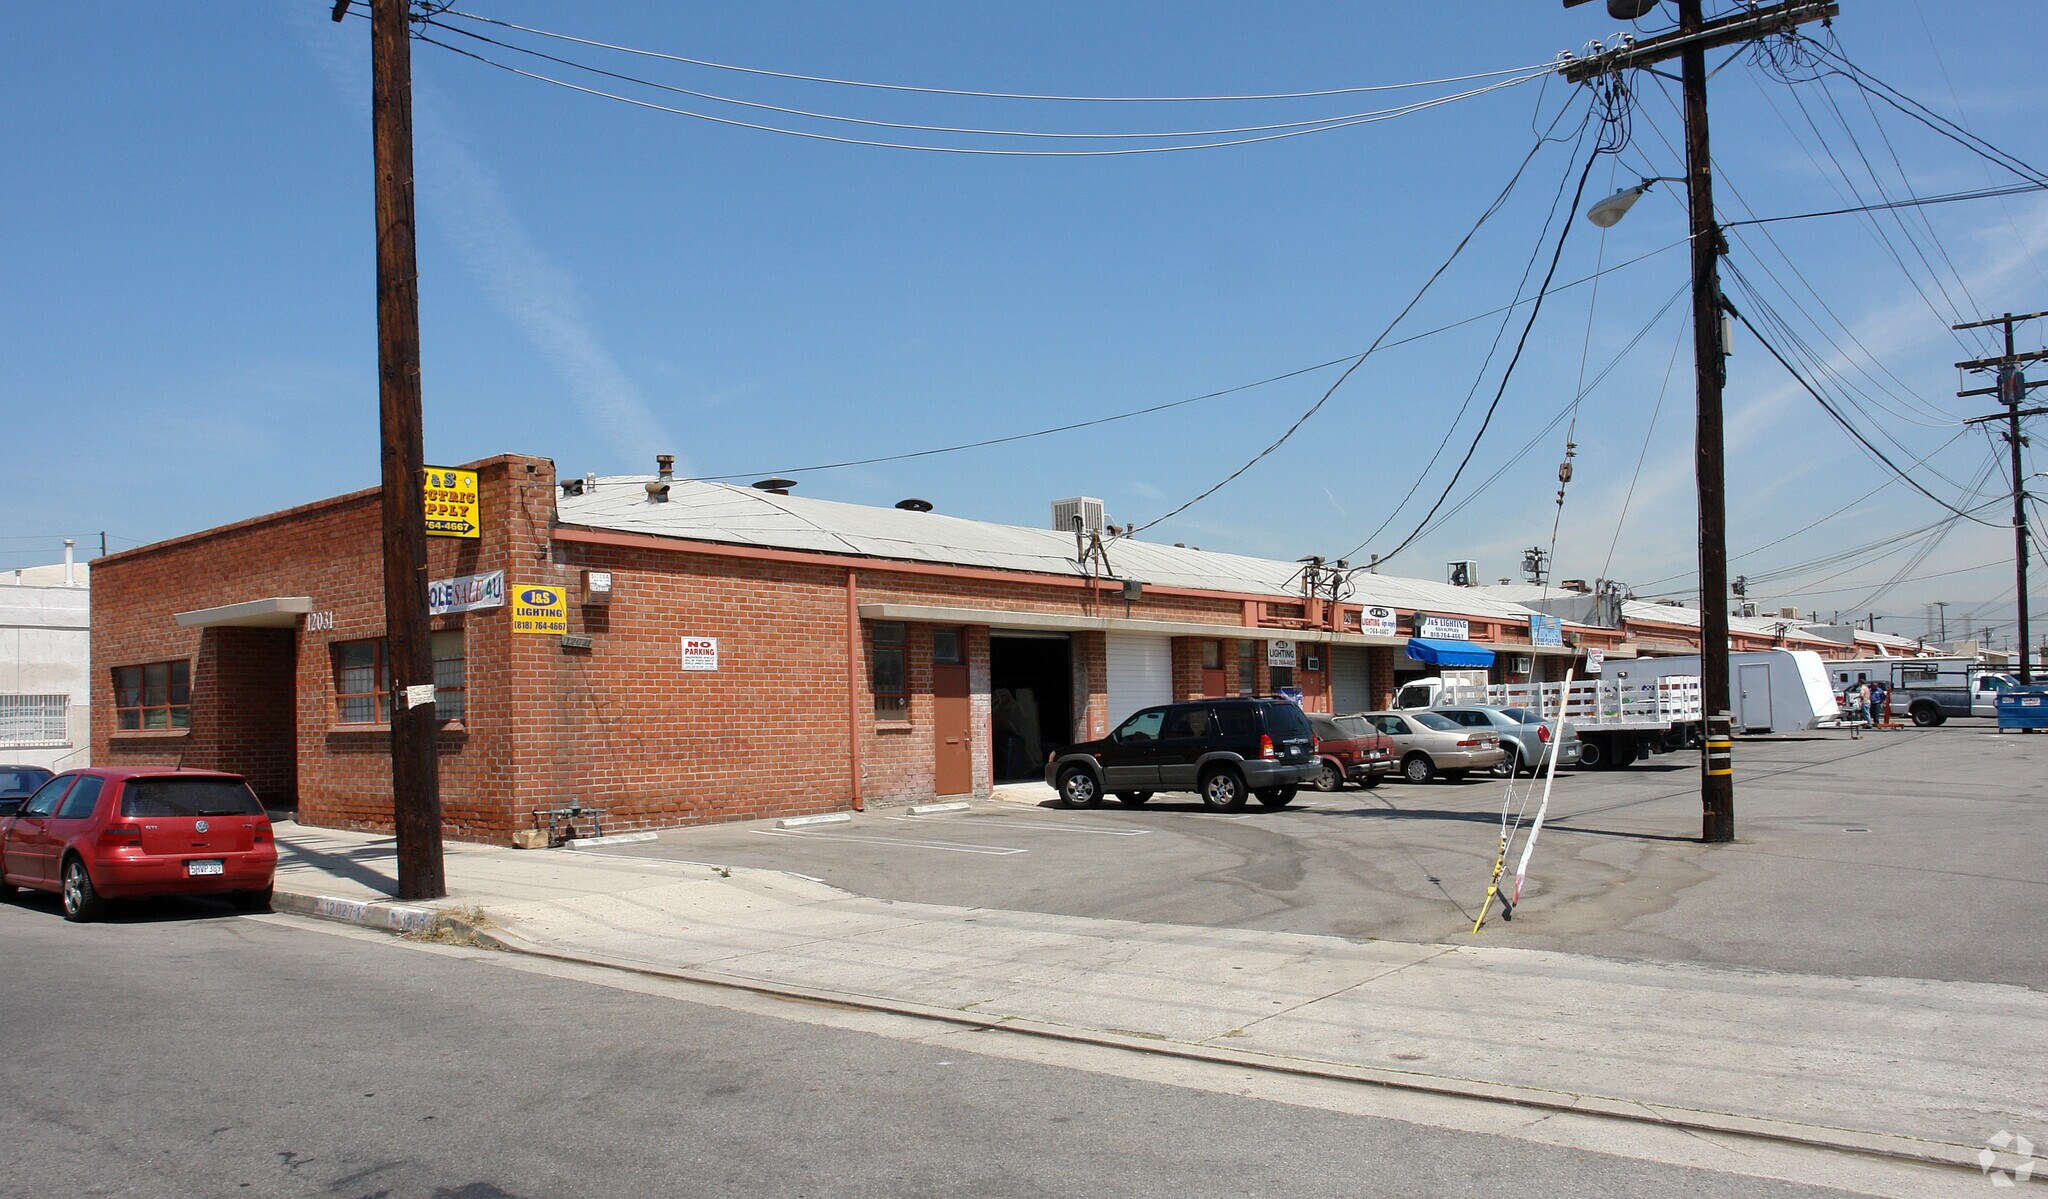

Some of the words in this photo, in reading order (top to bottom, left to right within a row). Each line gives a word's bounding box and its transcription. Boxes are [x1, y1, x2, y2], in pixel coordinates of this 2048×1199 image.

[425, 503, 469, 517] PPLY
[530, 591, 550, 604] J&S
[516, 608, 563, 618] LIGHTING
[1370, 609, 1387, 617] J&S
[307, 611, 333, 632] 12031
[514, 620, 532, 630] (818)
[535, 621, 566, 631] 764-4667
[1440, 619, 1467, 629] LIGHTING
[1269, 649, 1294, 659] LIGHTING
